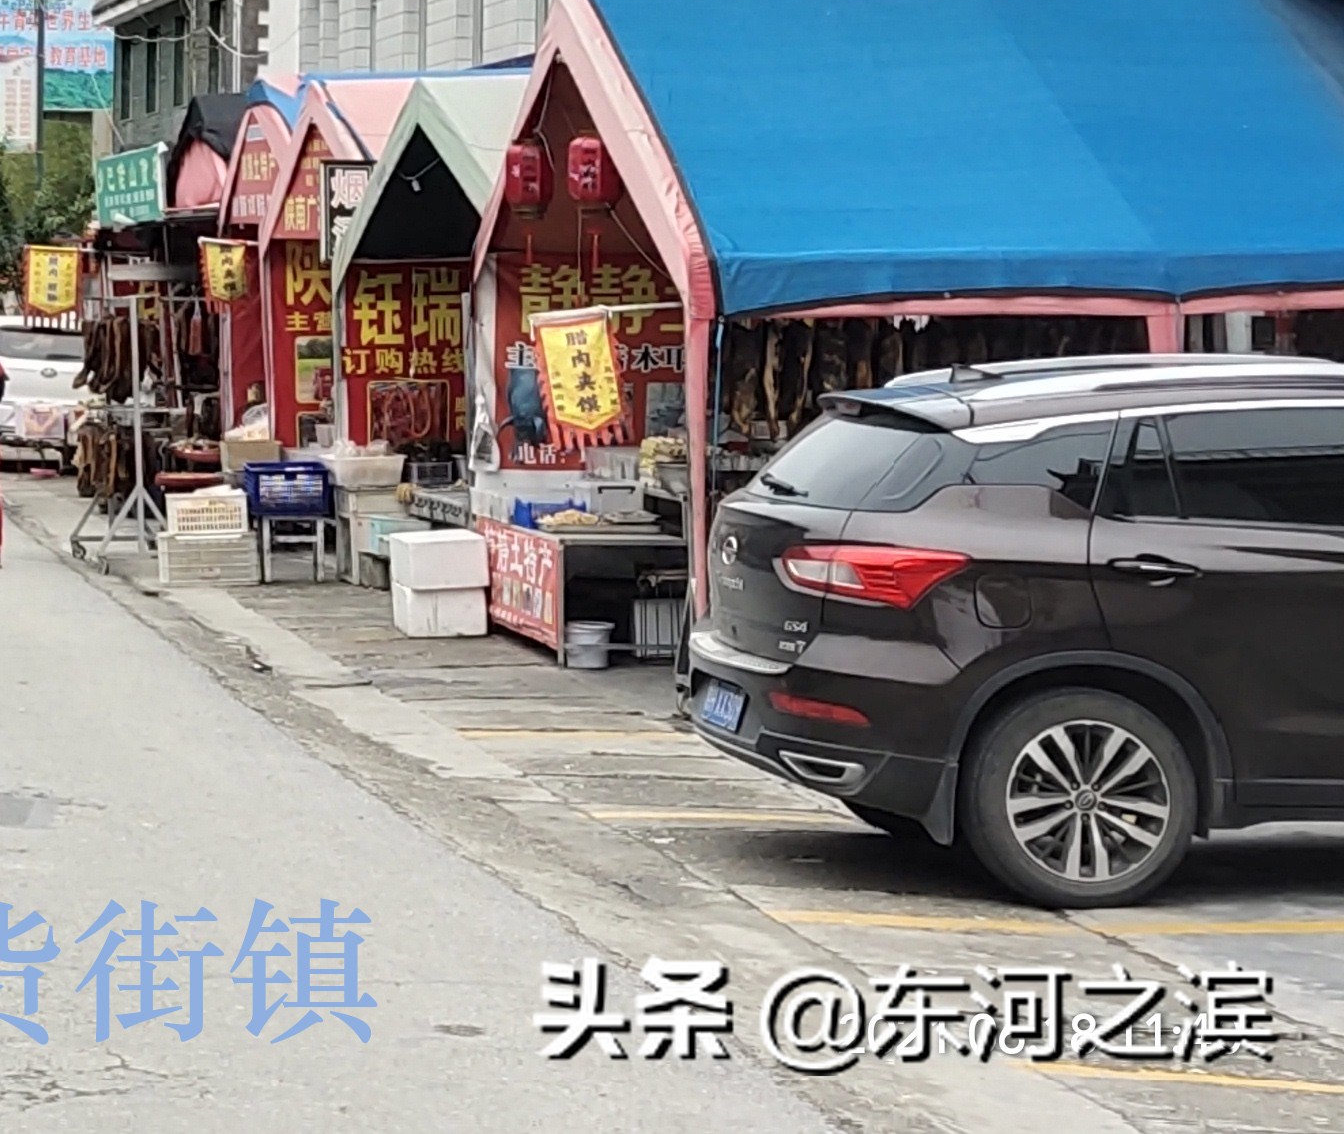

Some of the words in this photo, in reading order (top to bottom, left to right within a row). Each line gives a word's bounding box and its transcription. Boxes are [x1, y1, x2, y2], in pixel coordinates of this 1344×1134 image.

[283, 194, 321, 233] 陕南广
[352, 267, 461, 347] 钰瑞
[342, 347, 465, 374] 订购热线
